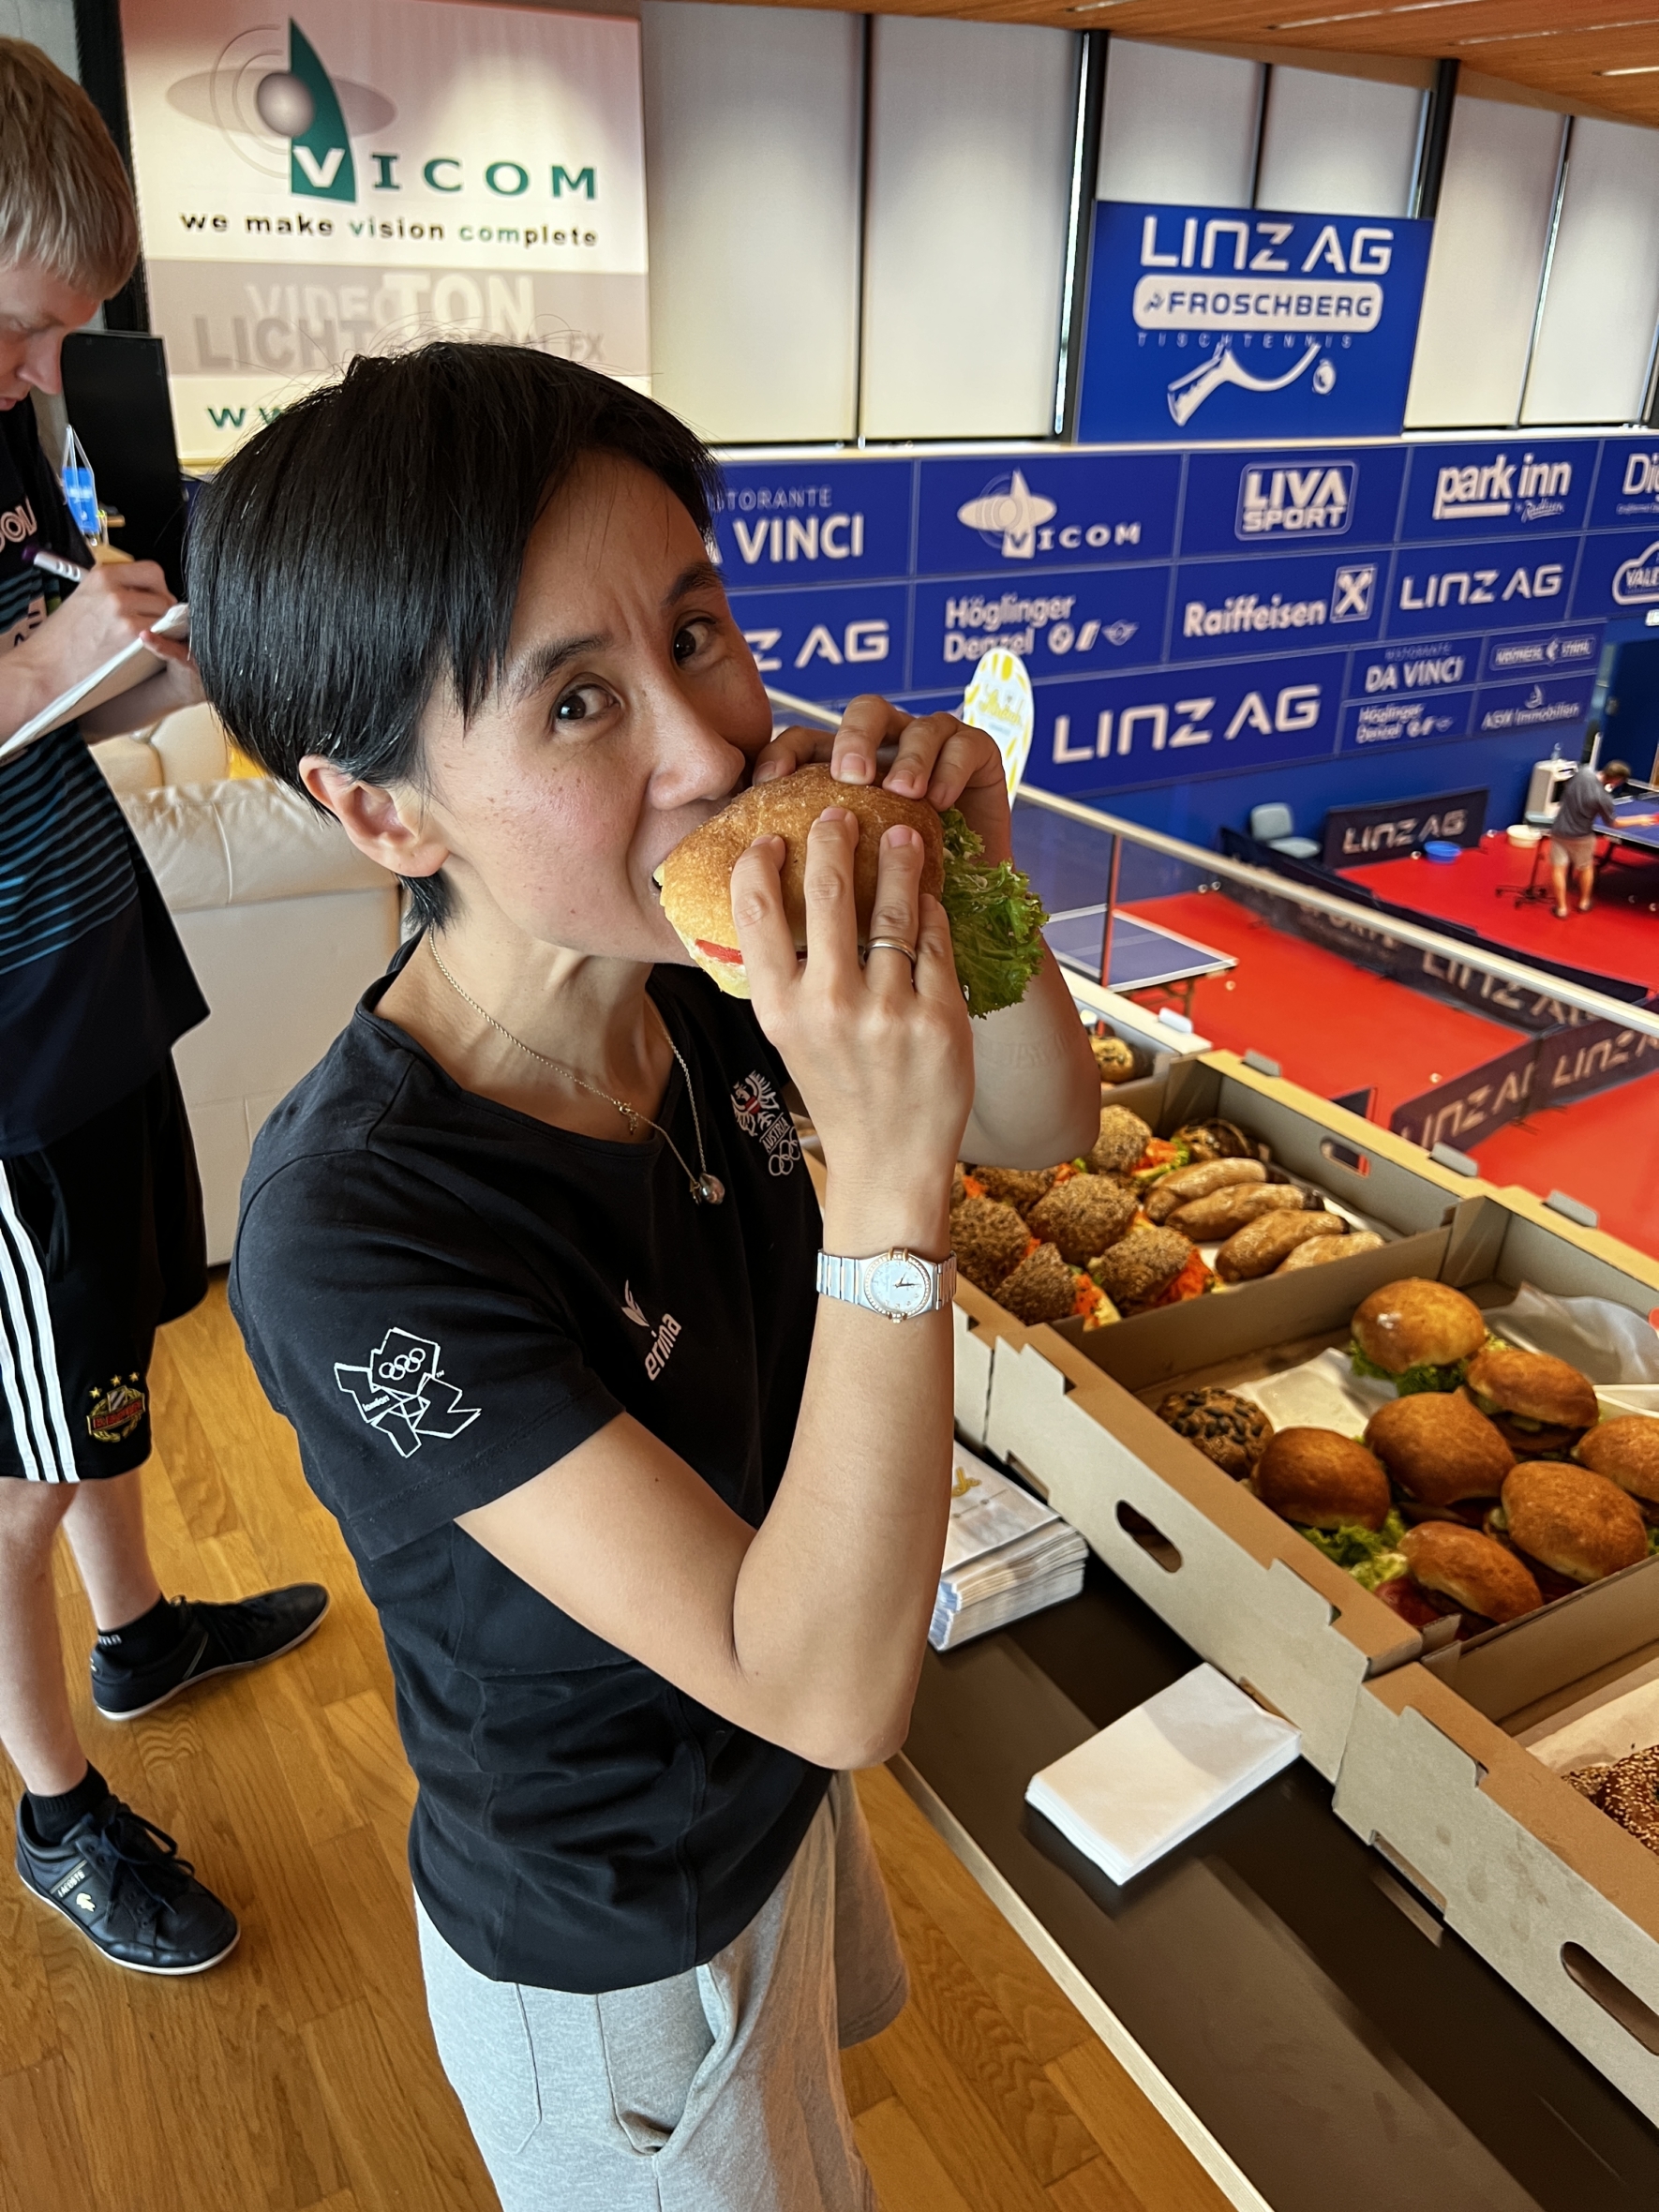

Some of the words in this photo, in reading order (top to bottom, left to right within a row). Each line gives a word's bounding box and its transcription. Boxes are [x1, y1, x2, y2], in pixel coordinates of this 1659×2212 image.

[291, 145, 597, 201] VICOM
[179, 213, 229, 232] we
[246, 212, 333, 235] make
[350, 215, 443, 239] vision
[459, 223, 596, 248] complete
[1140, 215, 1295, 272] LINZ
[1300, 225, 1394, 276] AG
[382, 273, 537, 344] TON
[1166, 291, 1373, 318] FROSCHBERG
[1136, 332, 1353, 348] TISCHTENNIS
[1244, 468, 1348, 510] LIVA
[1432, 454, 1517, 520] park
[1517, 452, 1573, 499] inn
[732, 512, 864, 564] VINCI
[1009, 521, 1143, 551] VICOM
[1243, 504, 1347, 532] SPORT
[1399, 569, 1498, 610] LINZ
[1502, 563, 1563, 601] AG
[945, 591, 1077, 632] Höglinger
[1183, 592, 1327, 637] Raiffeisen
[794, 620, 890, 668] AG
[1365, 664, 1398, 693] DA
[1403, 655, 1466, 688] VINCI
[1053, 696, 1217, 764] LINZ
[1223, 683, 1322, 740] AG
[760, 1116, 791, 1153] AUSTRIA
[645, 1313, 681, 1381] erima
